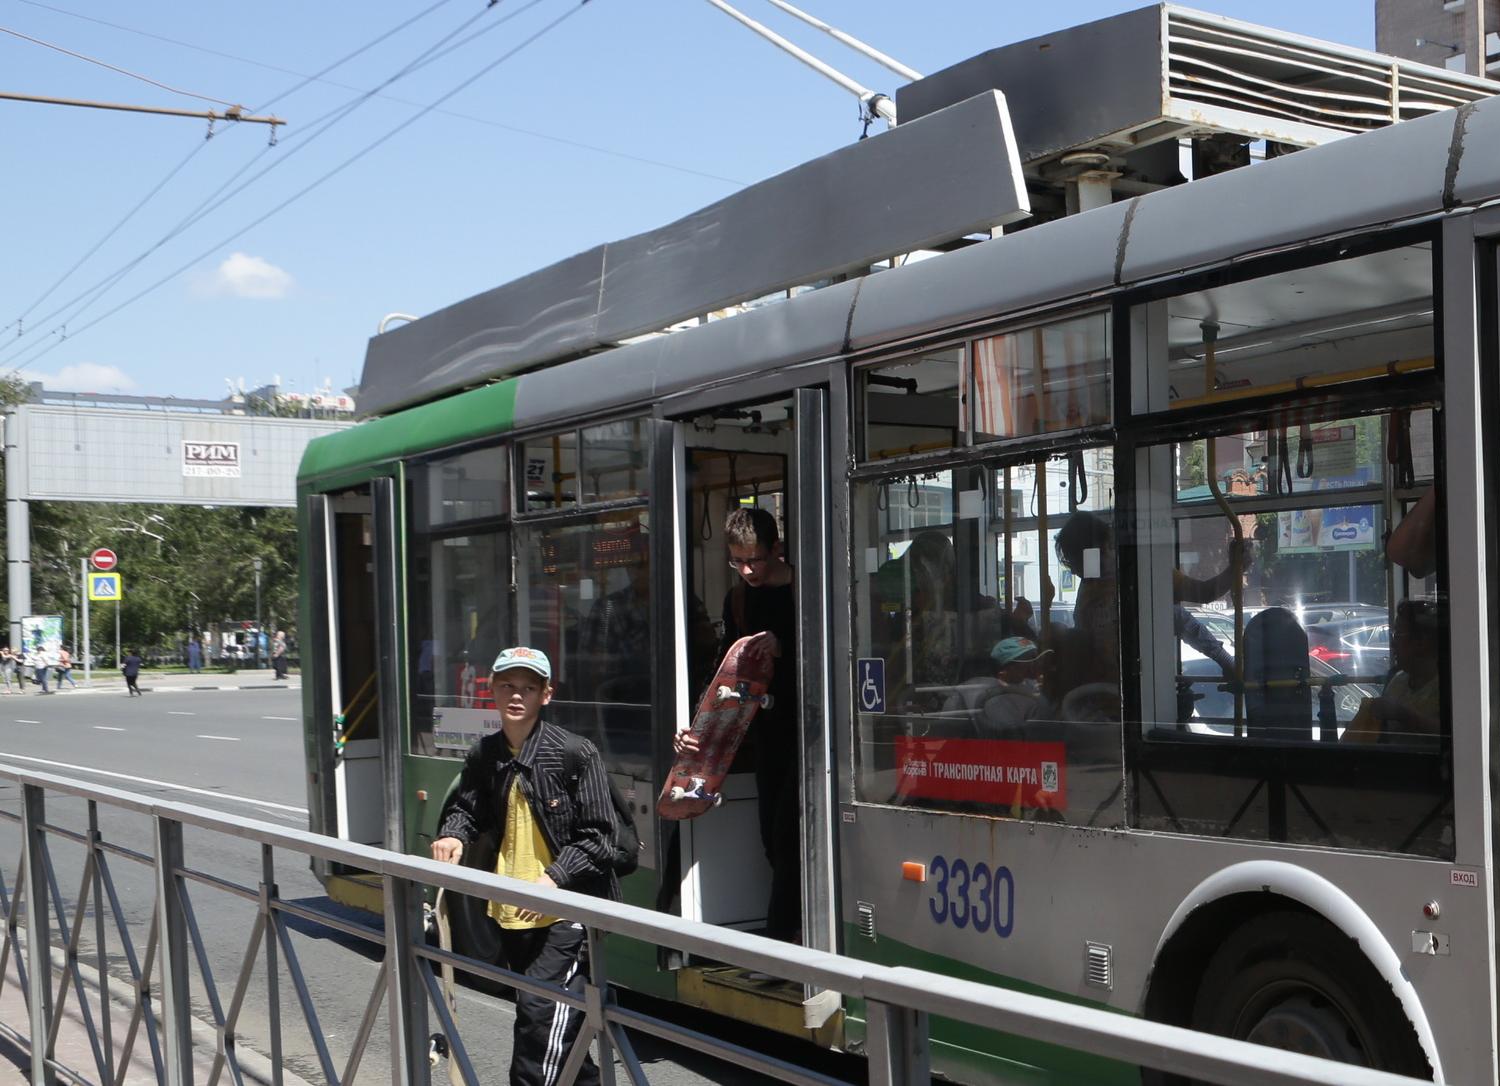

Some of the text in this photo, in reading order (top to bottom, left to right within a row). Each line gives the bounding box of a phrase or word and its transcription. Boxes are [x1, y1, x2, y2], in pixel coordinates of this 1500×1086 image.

[186, 445, 236, 460] РИМ
[932, 762, 1038, 785] ТРАНСПОРТНАЯ КАРТА
[1453, 872, 1475, 885] ВХОД
[929, 855, 1014, 938] 3330
